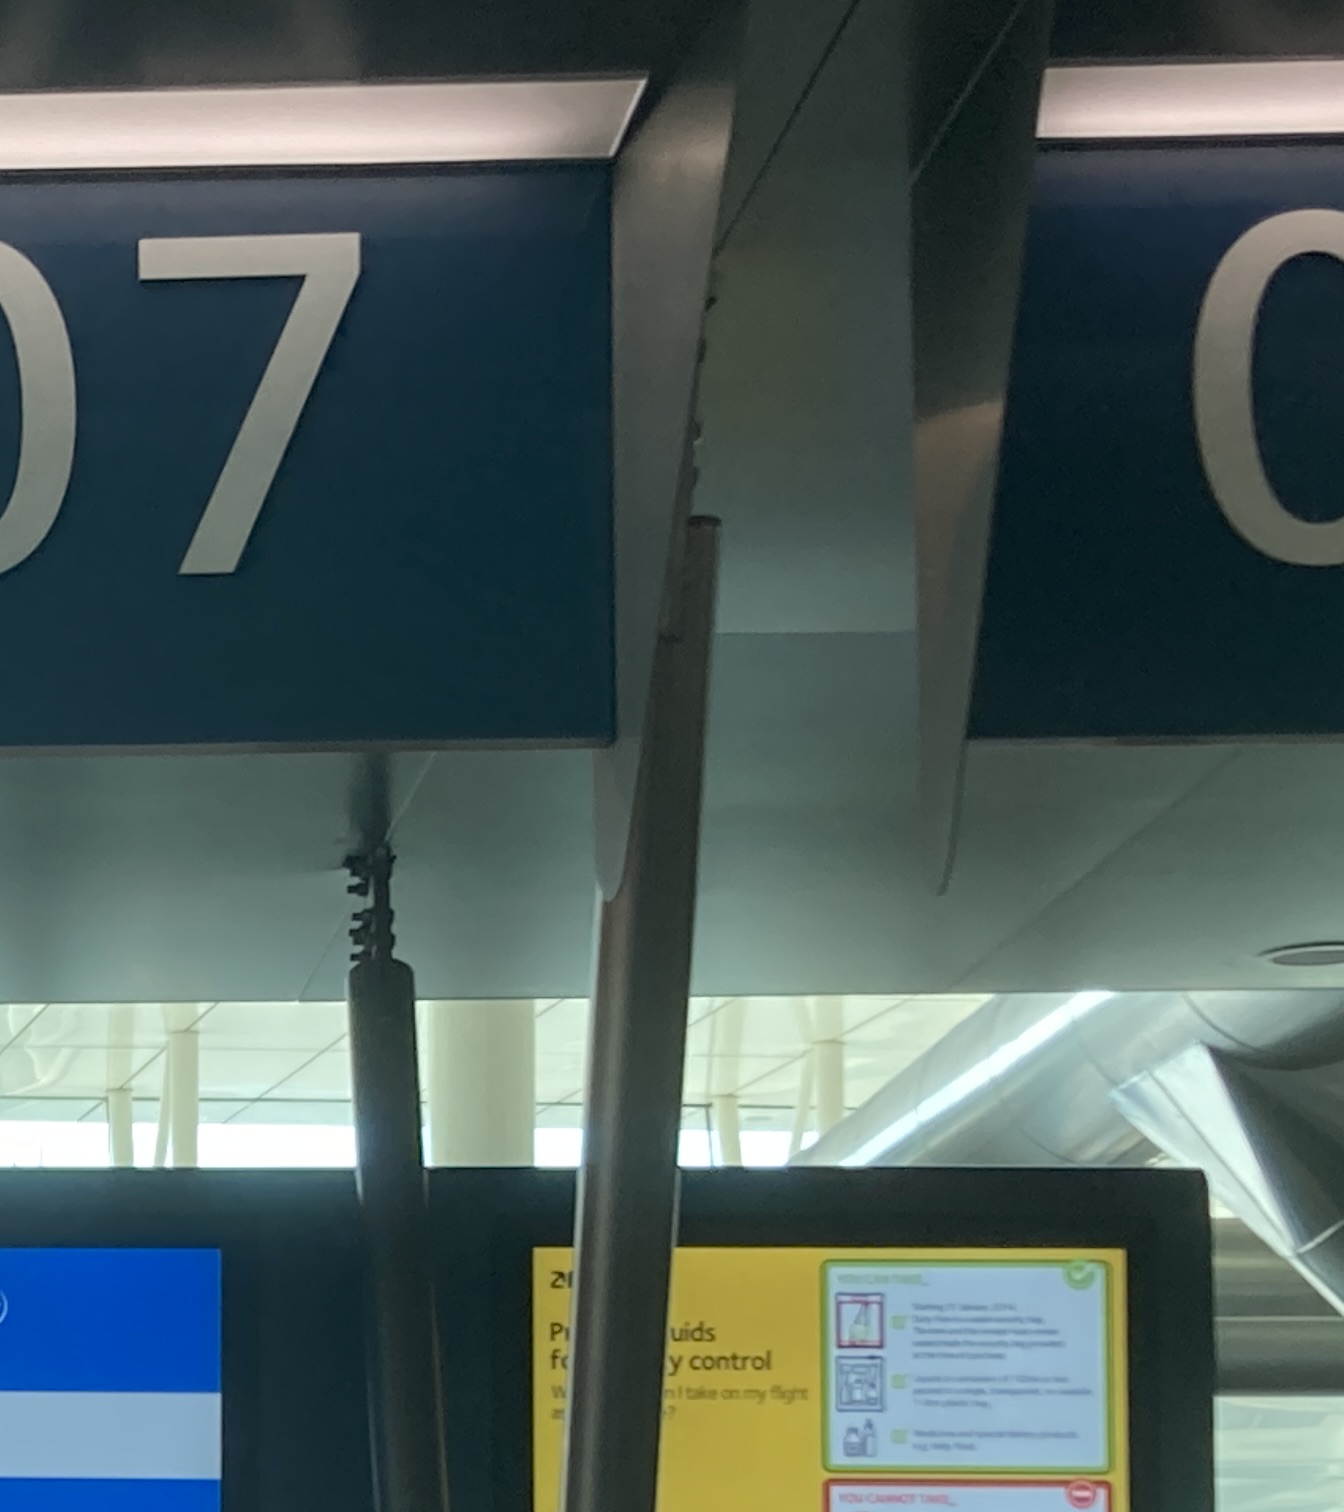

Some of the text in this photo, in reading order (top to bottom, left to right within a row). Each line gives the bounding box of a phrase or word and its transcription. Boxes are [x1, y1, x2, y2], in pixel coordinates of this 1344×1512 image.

[670, 1322, 716, 1342] uids
[689, 1351, 771, 1371] control
[685, 1386, 717, 1400] take
[769, 1385, 809, 1405] flight
